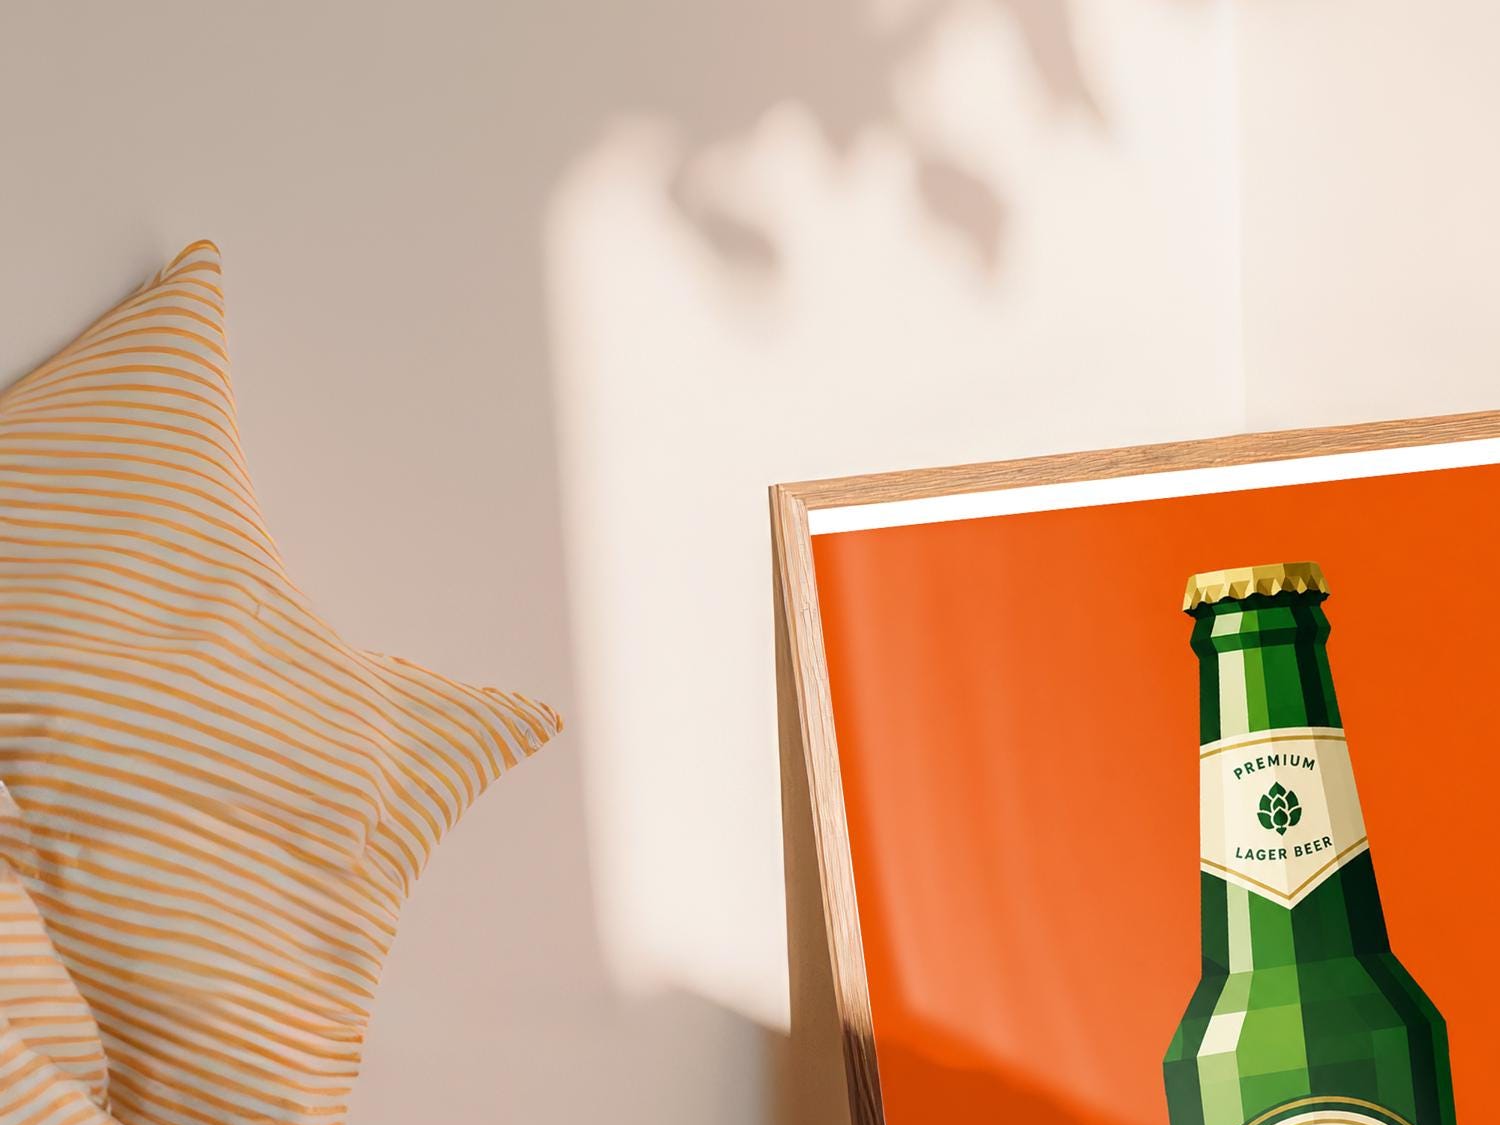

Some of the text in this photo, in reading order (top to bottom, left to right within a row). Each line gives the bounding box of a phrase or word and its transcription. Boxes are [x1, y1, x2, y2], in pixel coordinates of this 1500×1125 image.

[1233, 754, 1316, 780] PREMIUM
[1235, 836, 1333, 861] LAGER BEER
